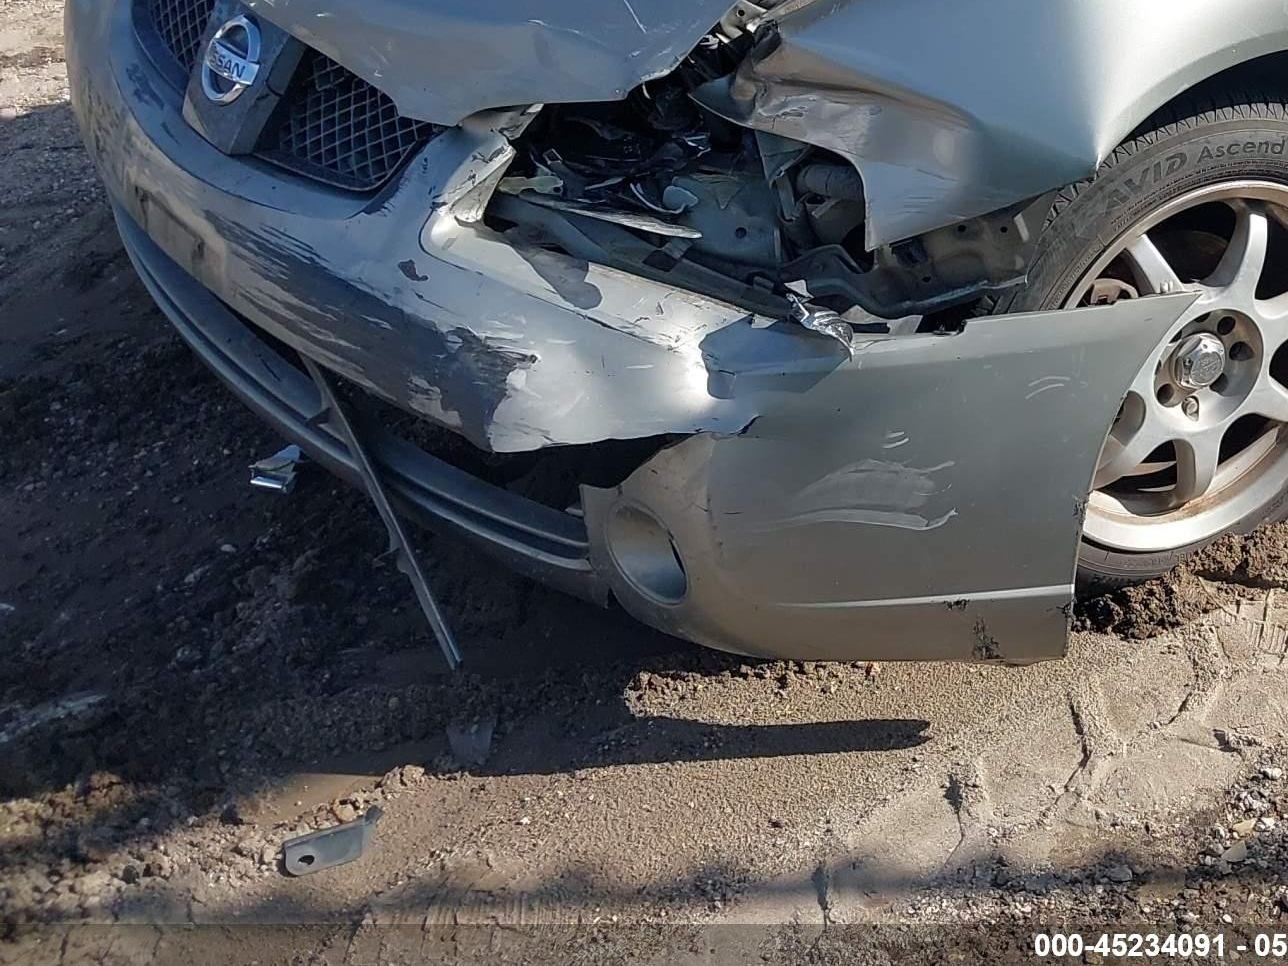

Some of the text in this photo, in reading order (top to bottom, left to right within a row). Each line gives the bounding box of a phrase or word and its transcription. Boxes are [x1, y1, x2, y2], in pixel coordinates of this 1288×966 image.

[208, 44, 246, 79] SSAN
[1100, 152, 1188, 217] AVID
[1197, 138, 1286, 164] Ascend
